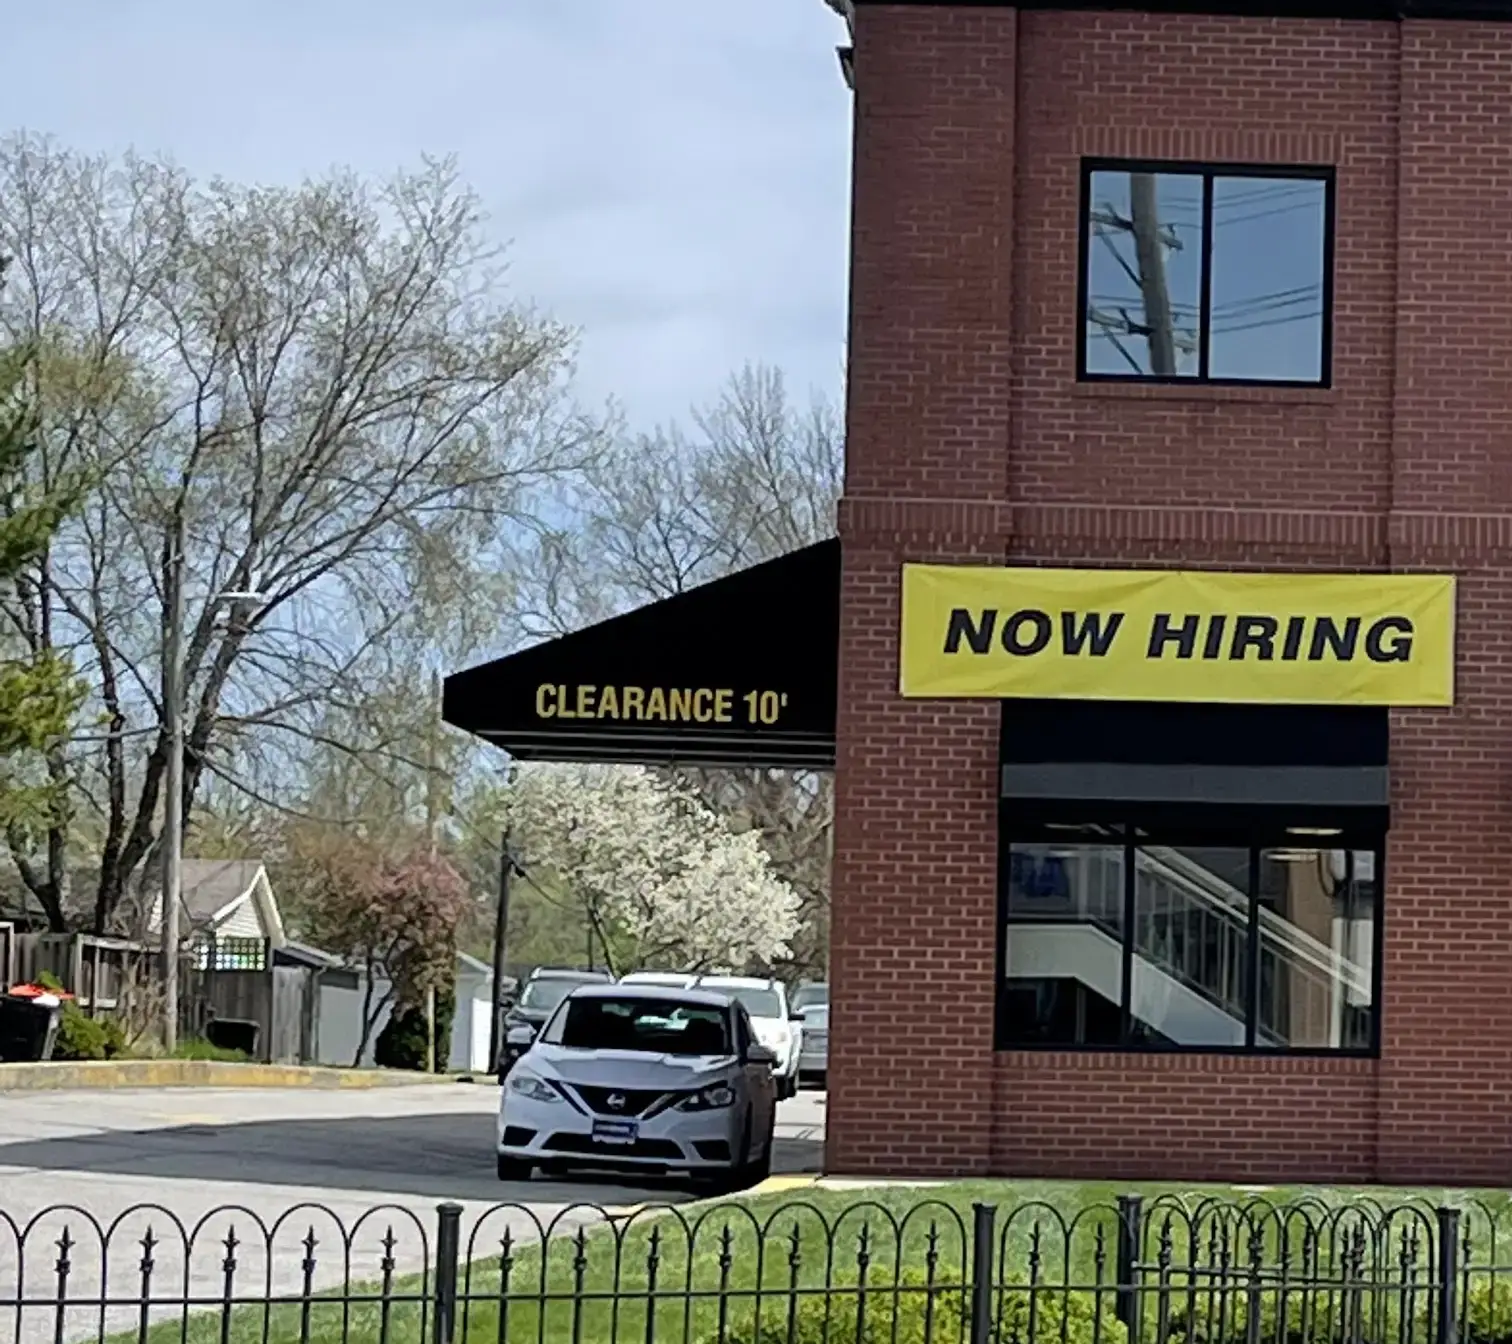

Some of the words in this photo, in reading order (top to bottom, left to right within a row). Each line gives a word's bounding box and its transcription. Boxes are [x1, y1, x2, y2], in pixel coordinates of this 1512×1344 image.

[943, 609, 1124, 657] NOW
[1146, 613, 1414, 663] HIRING
[535, 682, 734, 723] CLEARANCE
[743, 689, 788, 725] 10'
